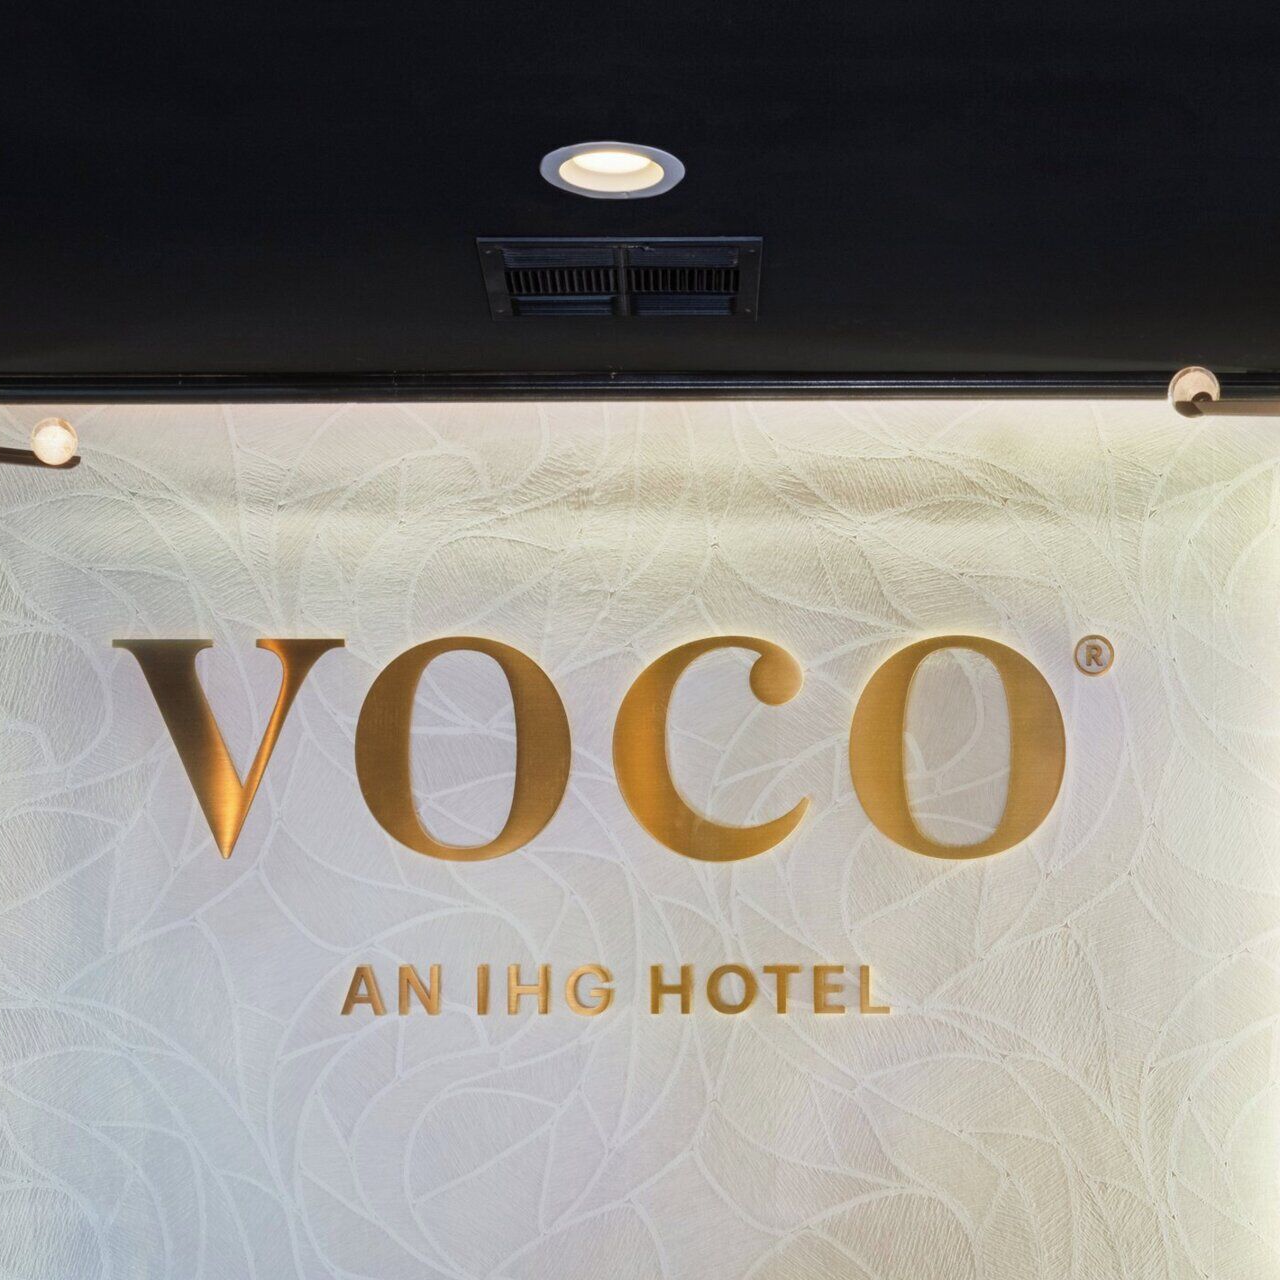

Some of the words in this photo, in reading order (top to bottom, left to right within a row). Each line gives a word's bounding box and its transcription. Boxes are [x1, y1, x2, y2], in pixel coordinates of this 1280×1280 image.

[341, 963, 442, 1015] AN
[475, 963, 615, 1016] IHG
[650, 963, 891, 1015] HOTEL
